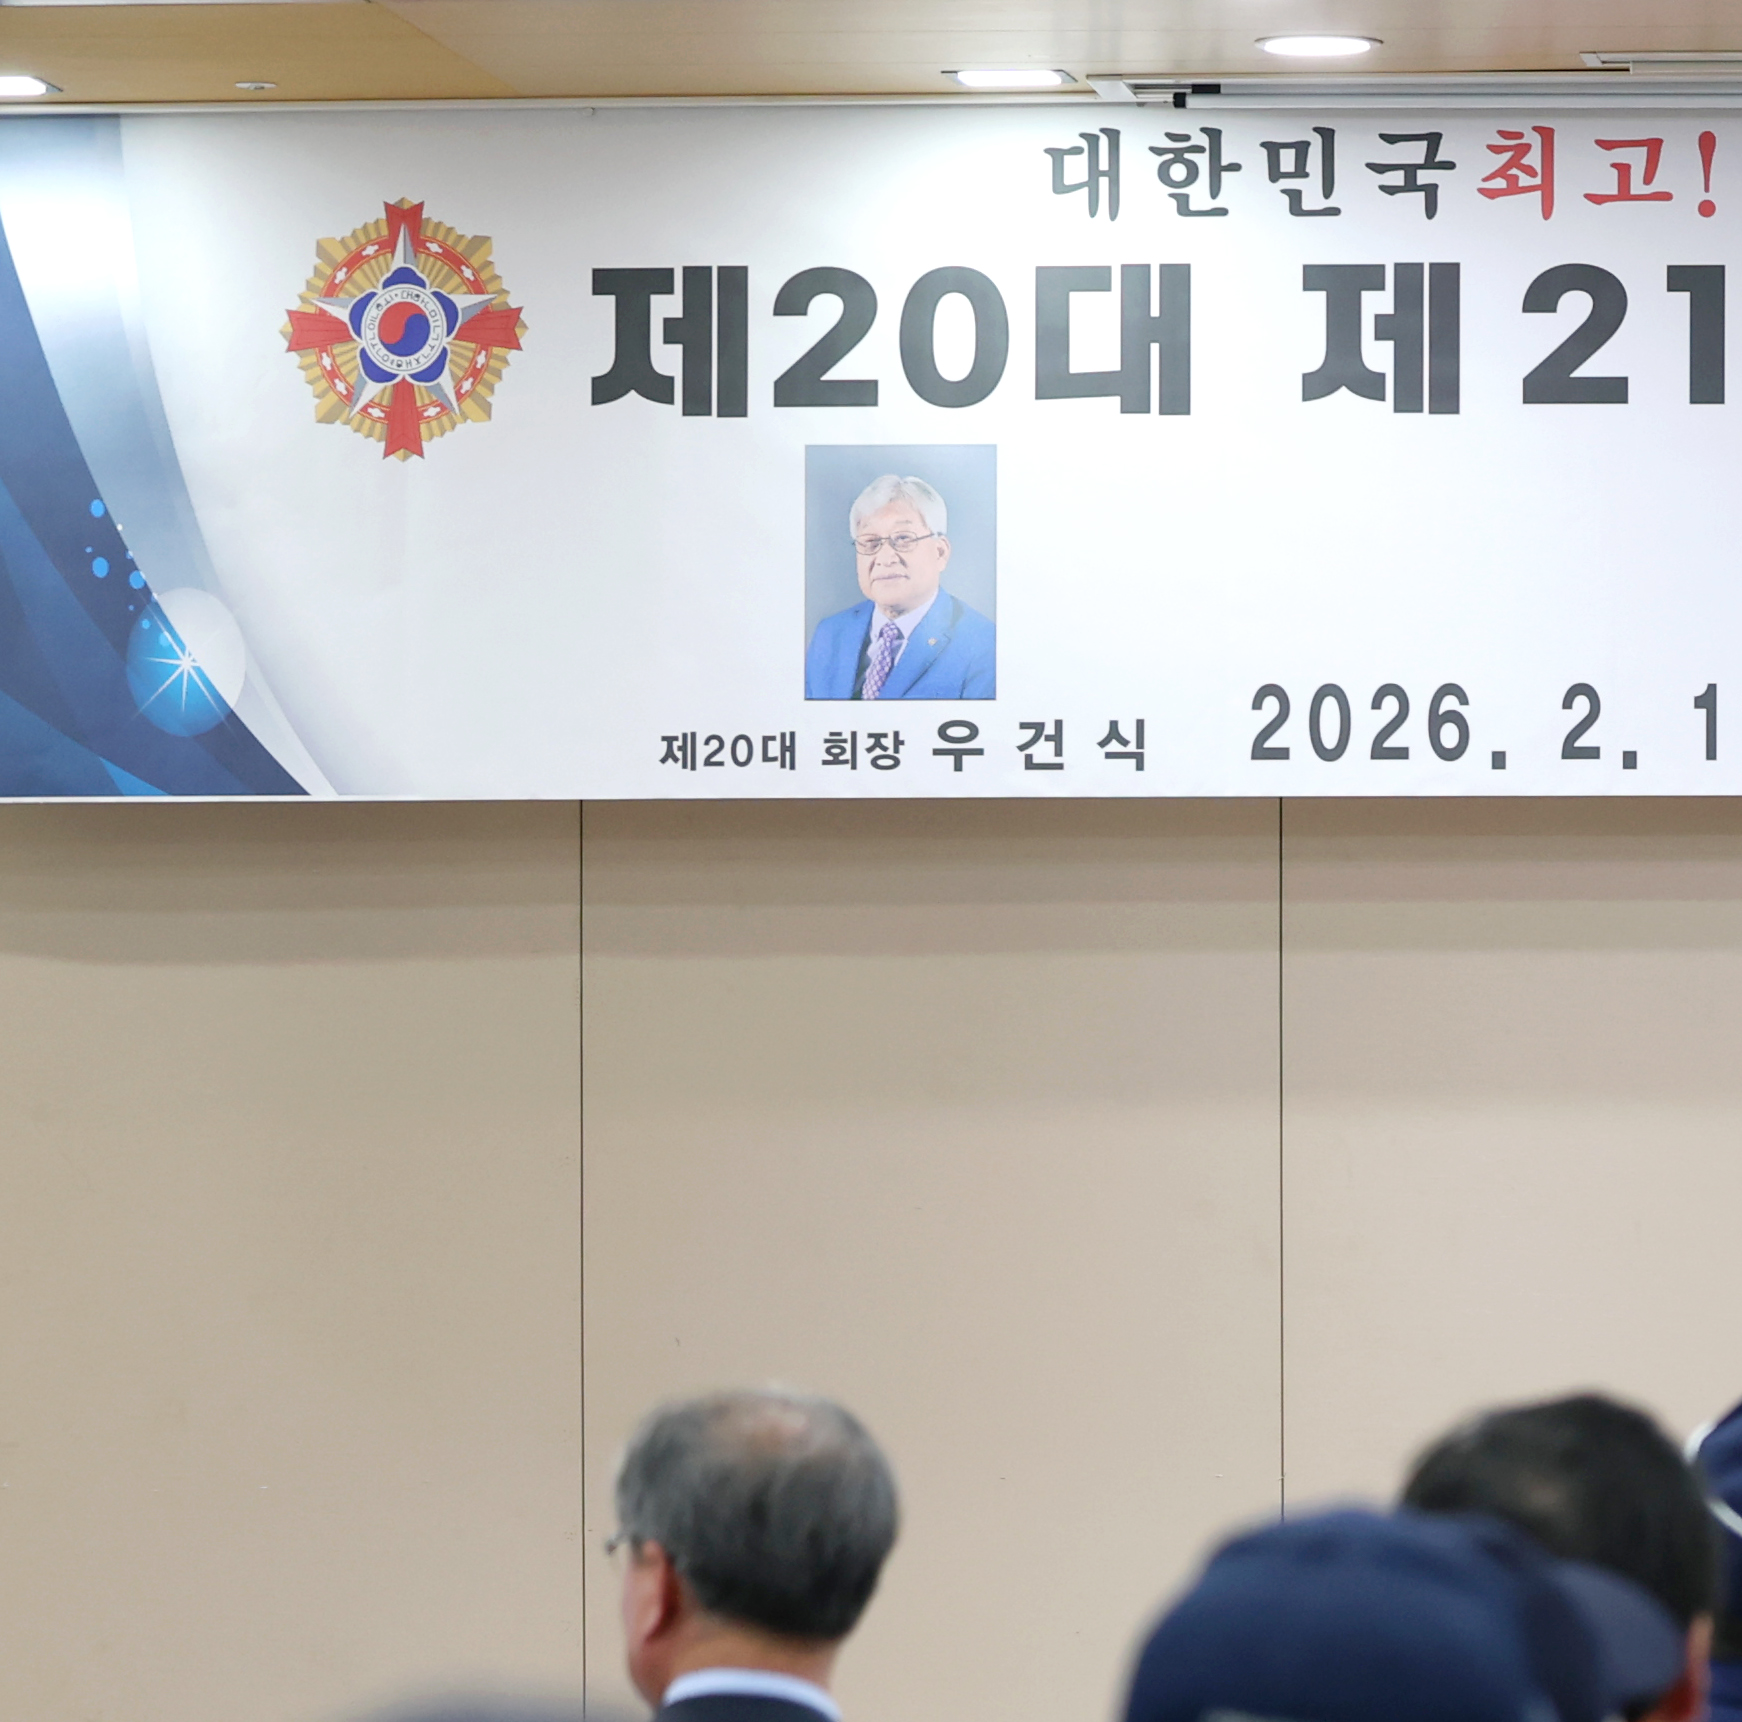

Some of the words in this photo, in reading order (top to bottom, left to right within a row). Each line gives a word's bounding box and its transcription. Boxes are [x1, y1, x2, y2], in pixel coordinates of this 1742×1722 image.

[591, 264, 1192, 420] 제20대
[660, 731, 797, 773] 제20대
[822, 731, 907, 772] 회장
[1251, 683, 1508, 772] 2026.
[1561, 683, 1639, 771] 2.
